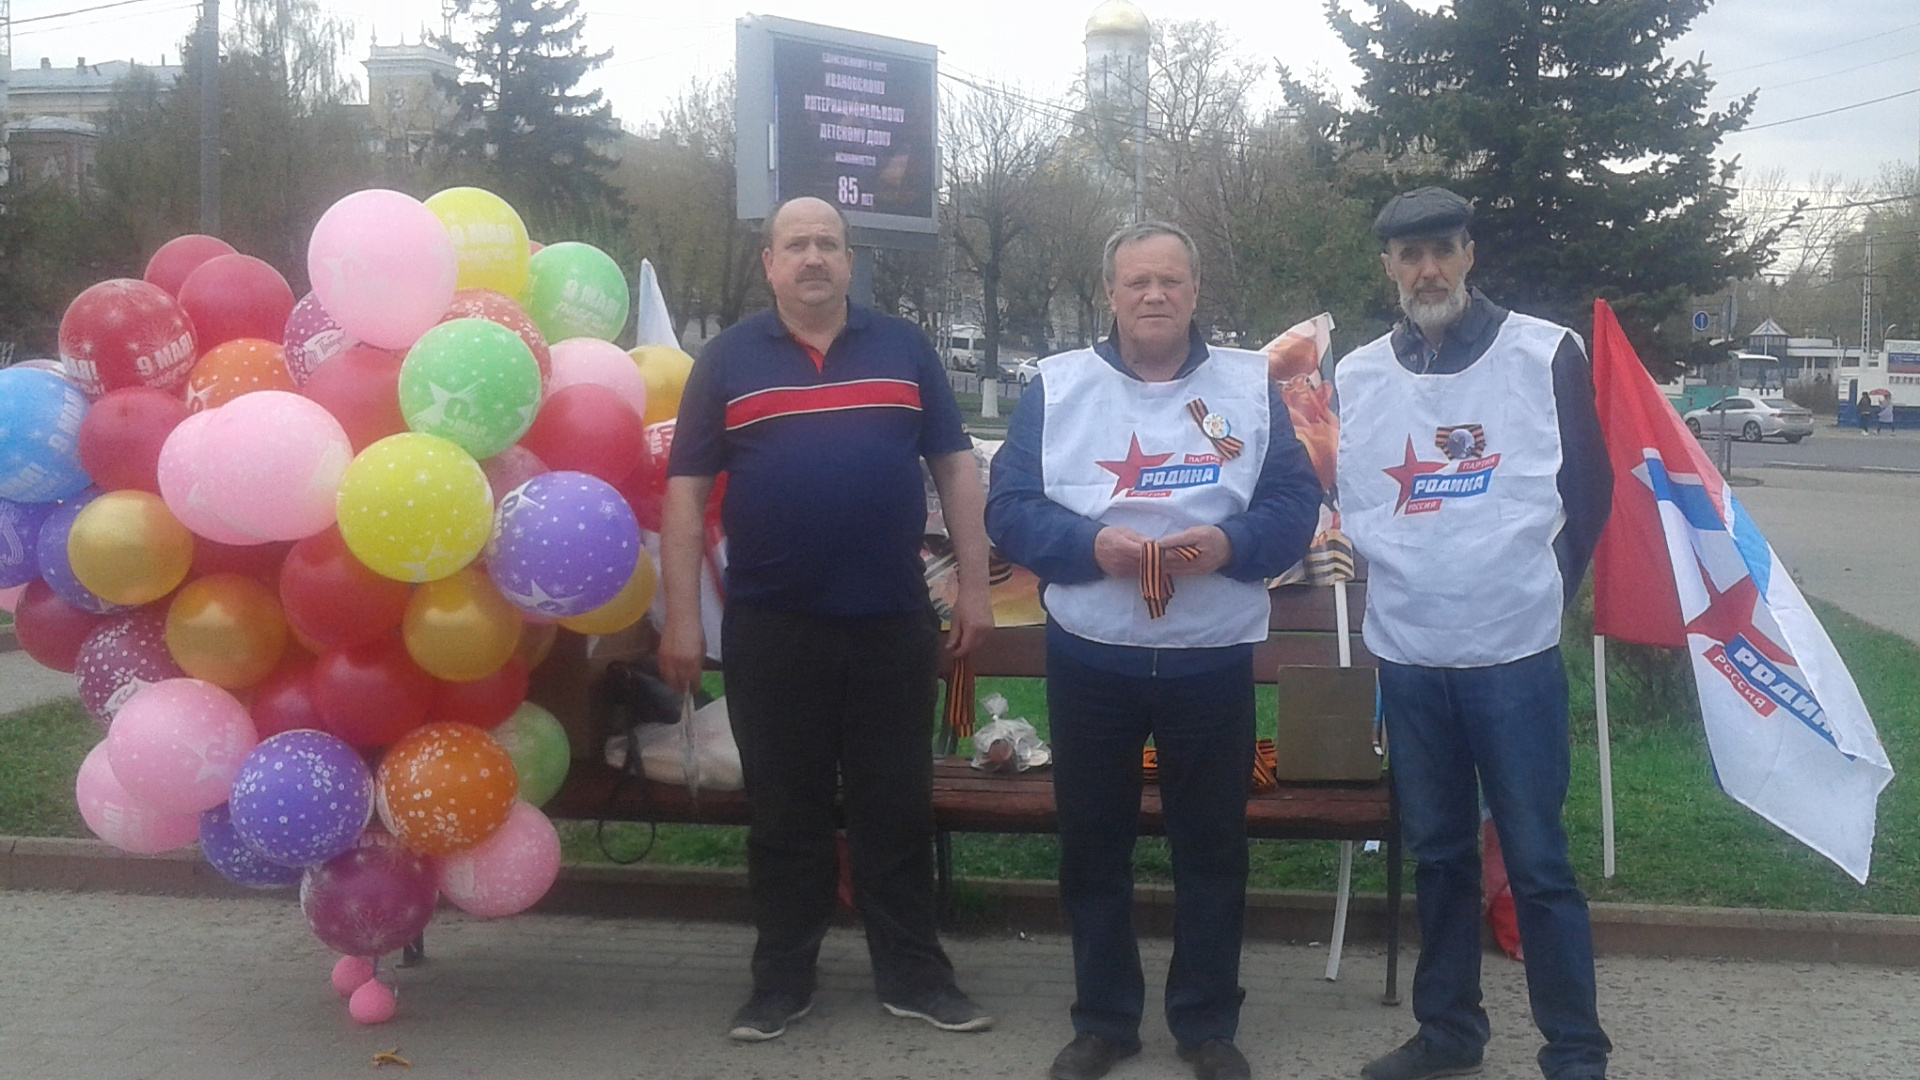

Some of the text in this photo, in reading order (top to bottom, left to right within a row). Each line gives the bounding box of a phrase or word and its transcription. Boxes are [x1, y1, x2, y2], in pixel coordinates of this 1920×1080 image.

[825, 73, 886, 95] ИВАНОВСКОМУ
[805, 94, 905, 123] ИНТЕРНАЦИОНАЛЬНОМУ
[820, 123, 891, 147] ДЕТСКОМУ ДОМУ
[838, 175, 859, 205] 85
[136, 355, 154, 376] 9
[154, 331, 194, 370] МАЯ!
[1188, 454, 1221, 464] ПАРТИЯ
[1462, 456, 1496, 470] ПАРТИЯ
[1141, 467, 1215, 487] РОДИНА
[1414, 474, 1486, 494] РОДИНА
[1408, 500, 1438, 512] РОССИЯ
[1713, 653, 1768, 710] РОССИЯ
[1734, 646, 1832, 735] РОДИН
